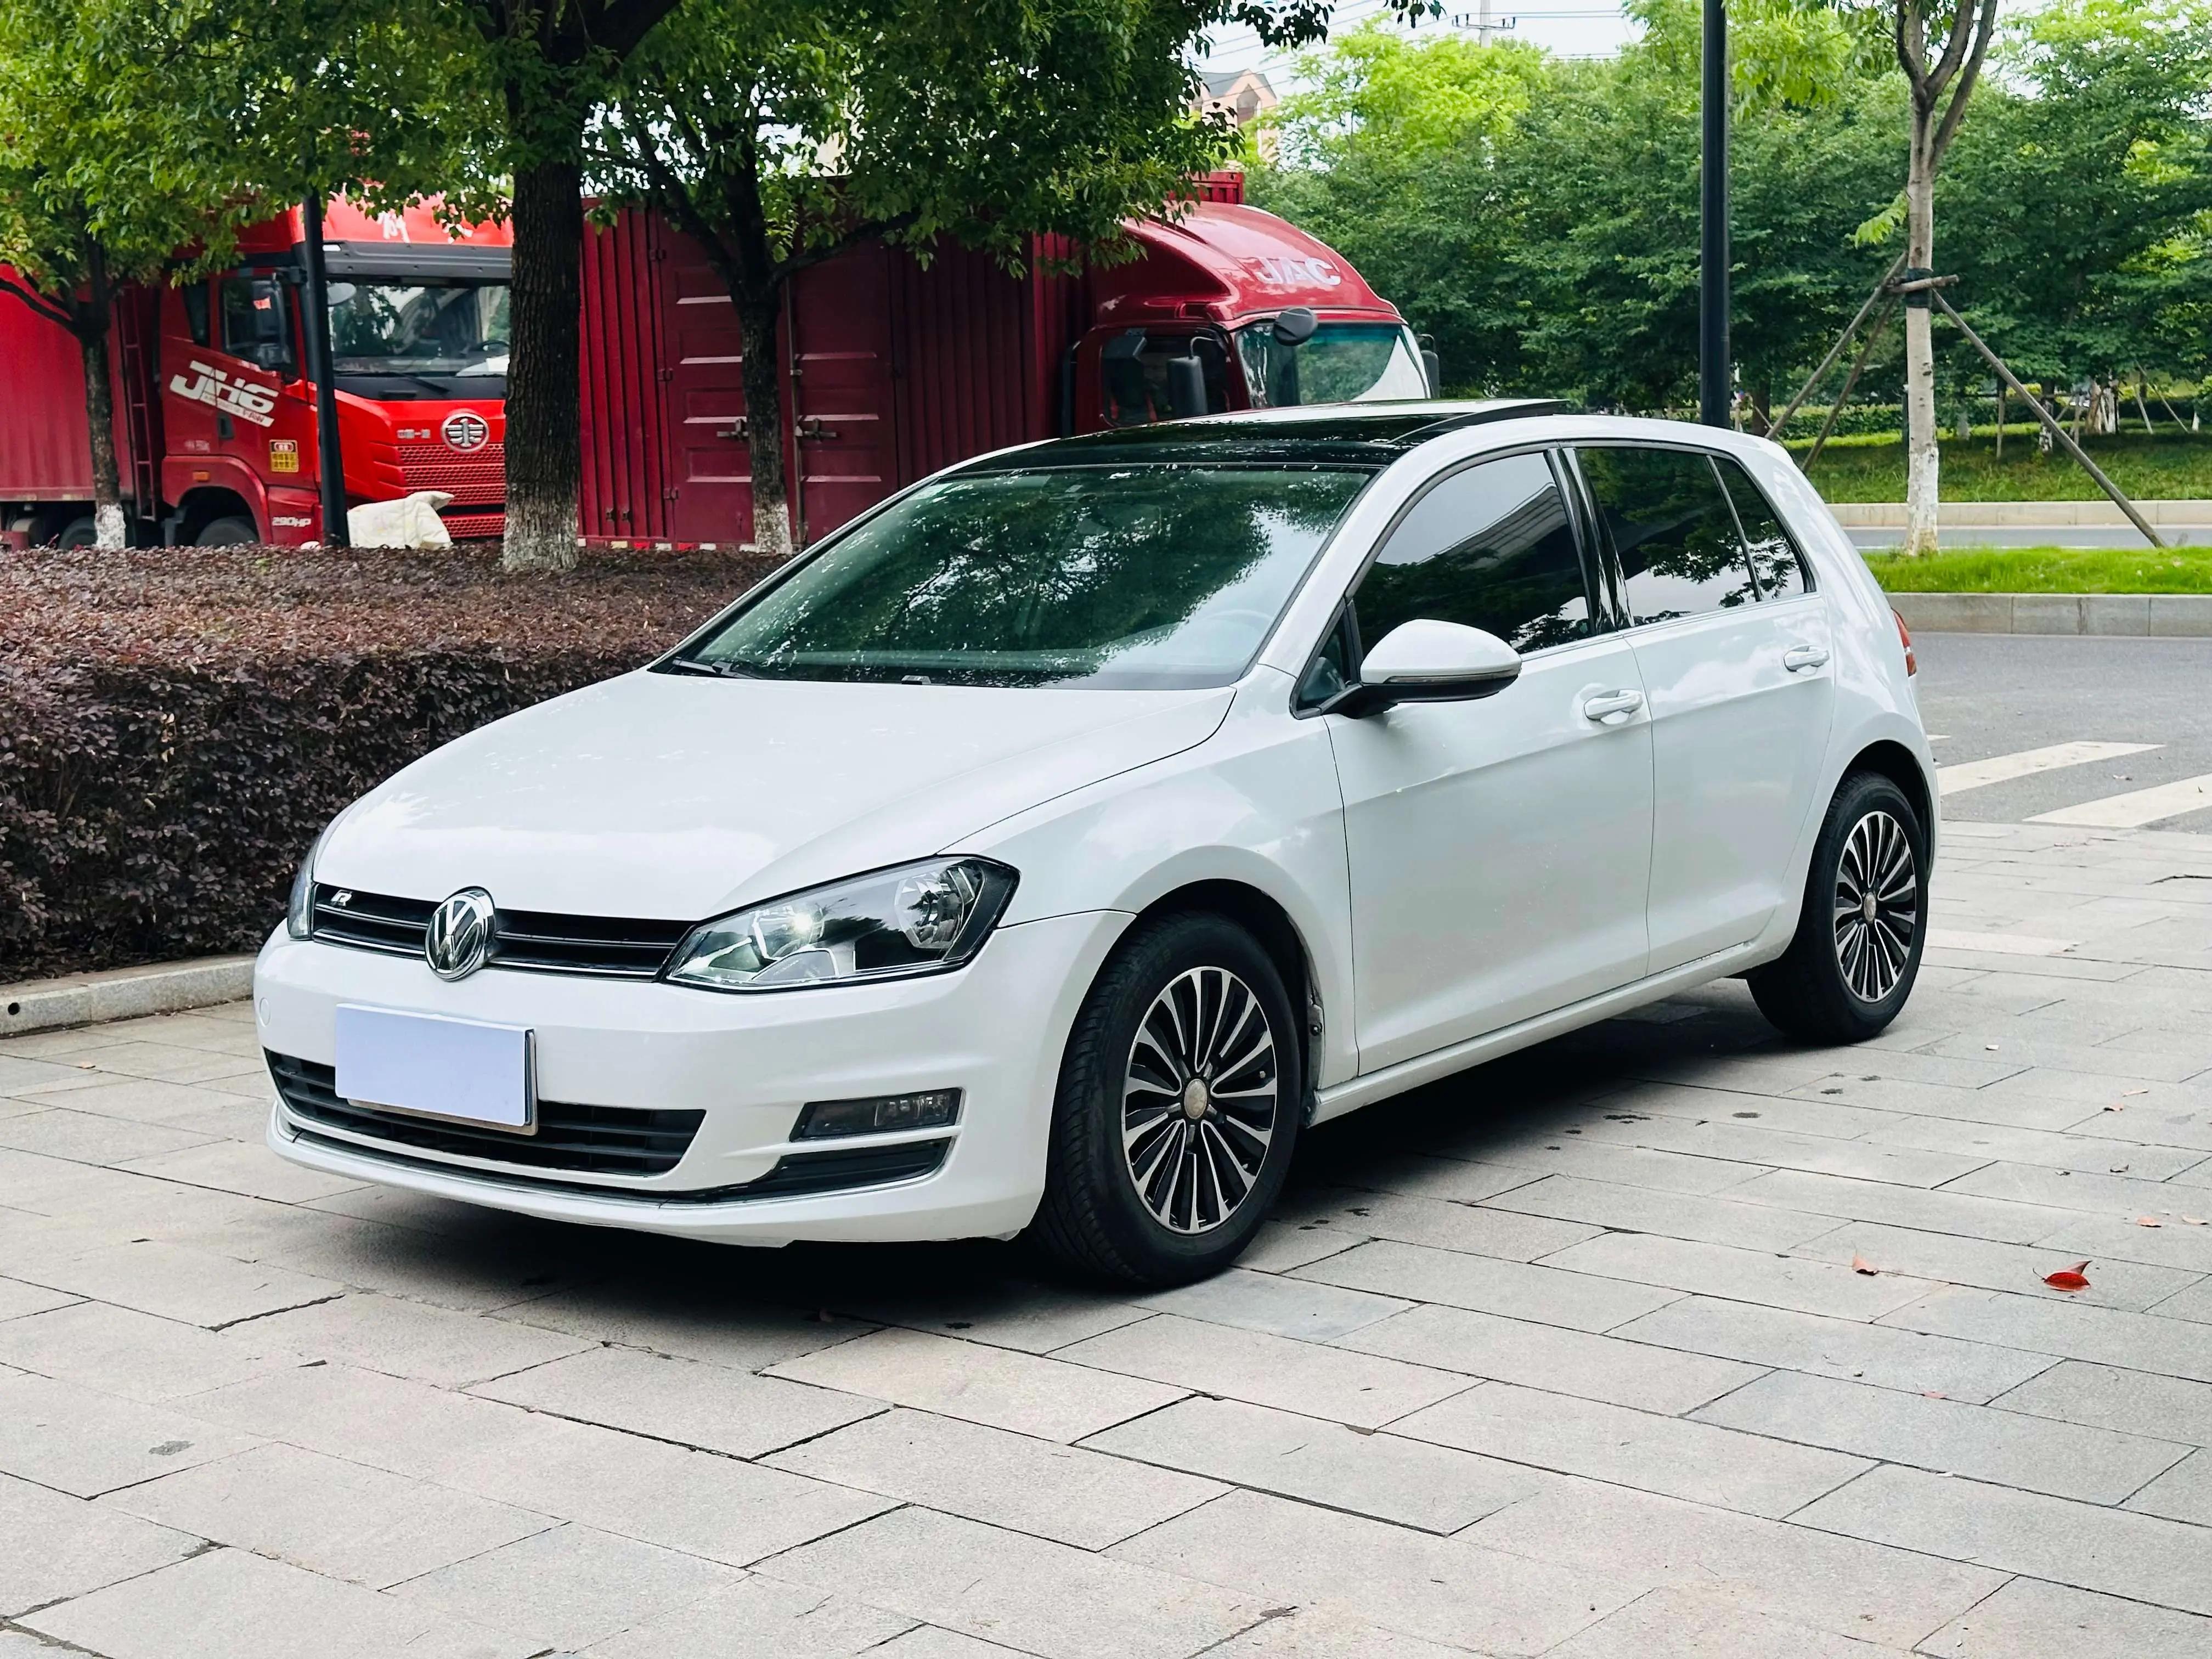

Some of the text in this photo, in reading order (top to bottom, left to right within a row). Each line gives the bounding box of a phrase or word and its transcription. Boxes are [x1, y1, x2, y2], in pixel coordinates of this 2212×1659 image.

[1255, 257, 1341, 286] JAC
[170, 360, 279, 414] JH6
[331, 889, 353, 907] R
